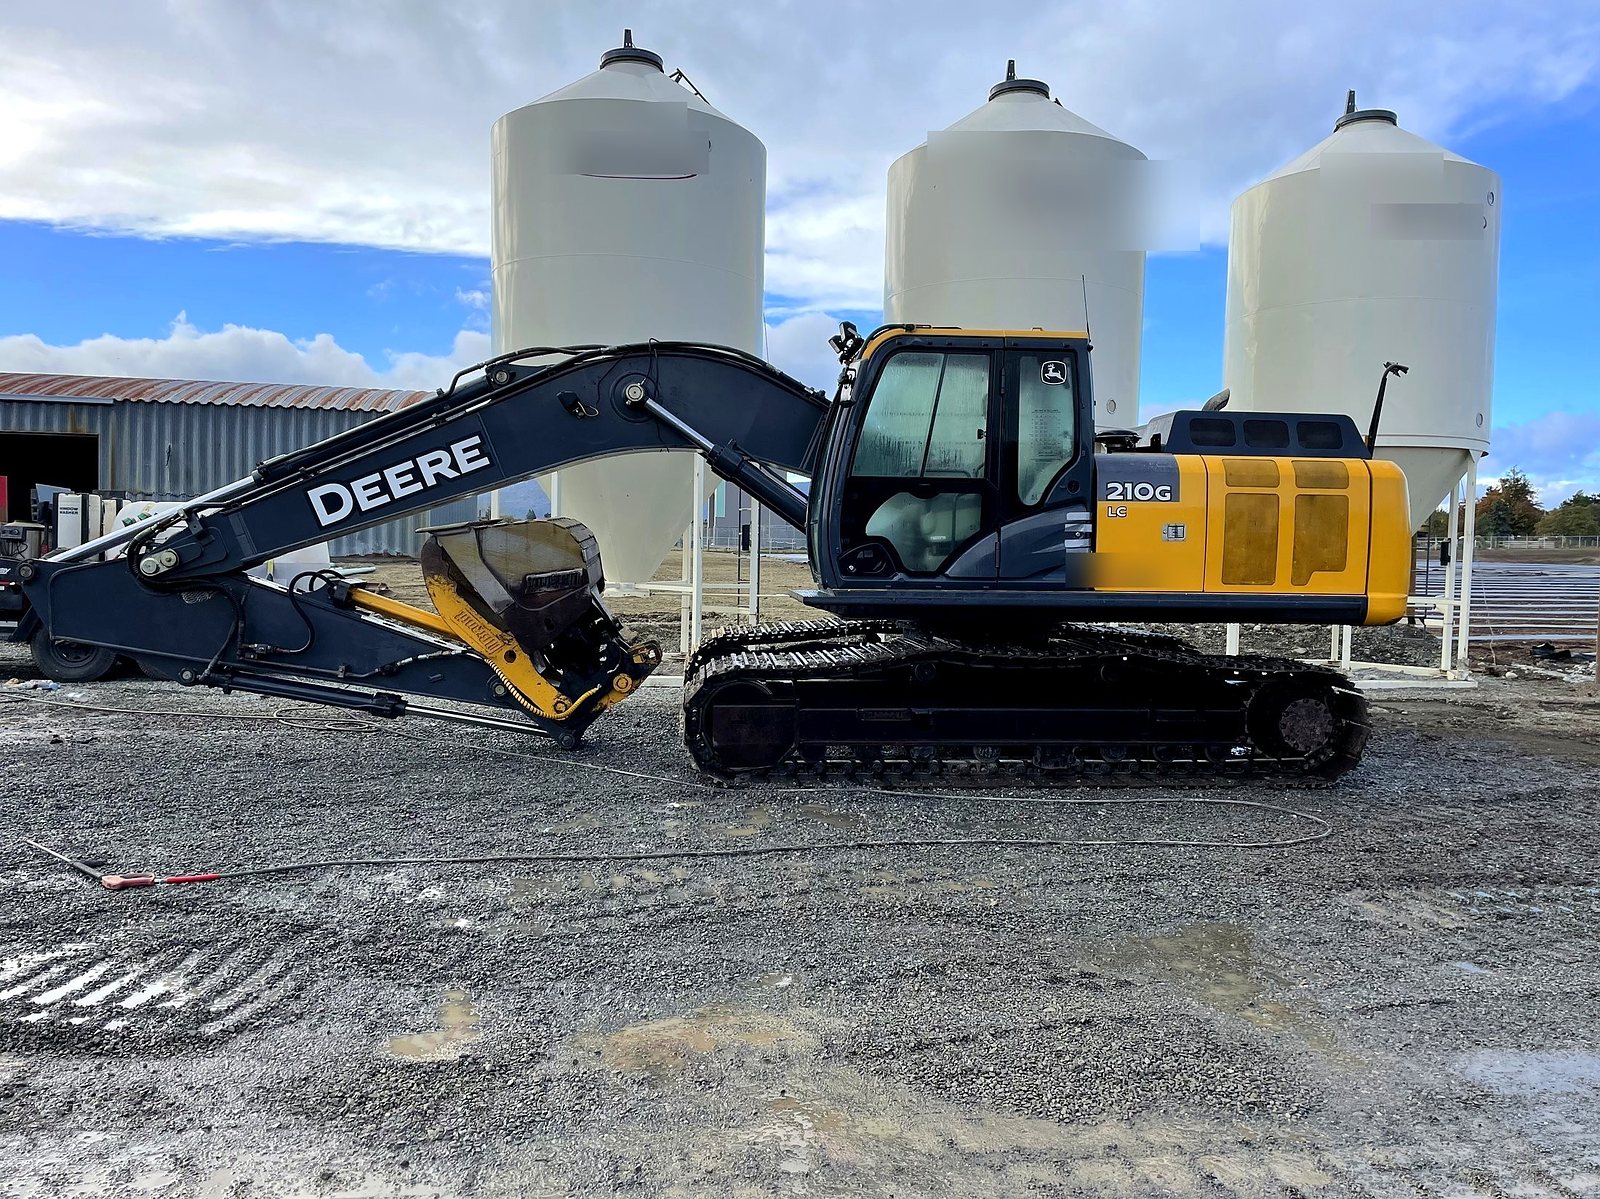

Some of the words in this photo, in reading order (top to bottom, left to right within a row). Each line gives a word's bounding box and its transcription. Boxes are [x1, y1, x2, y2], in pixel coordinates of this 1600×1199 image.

[307, 435, 490, 527] DEERE
[1107, 482, 1171, 501] 210G
[1108, 506, 1127, 517] LC
